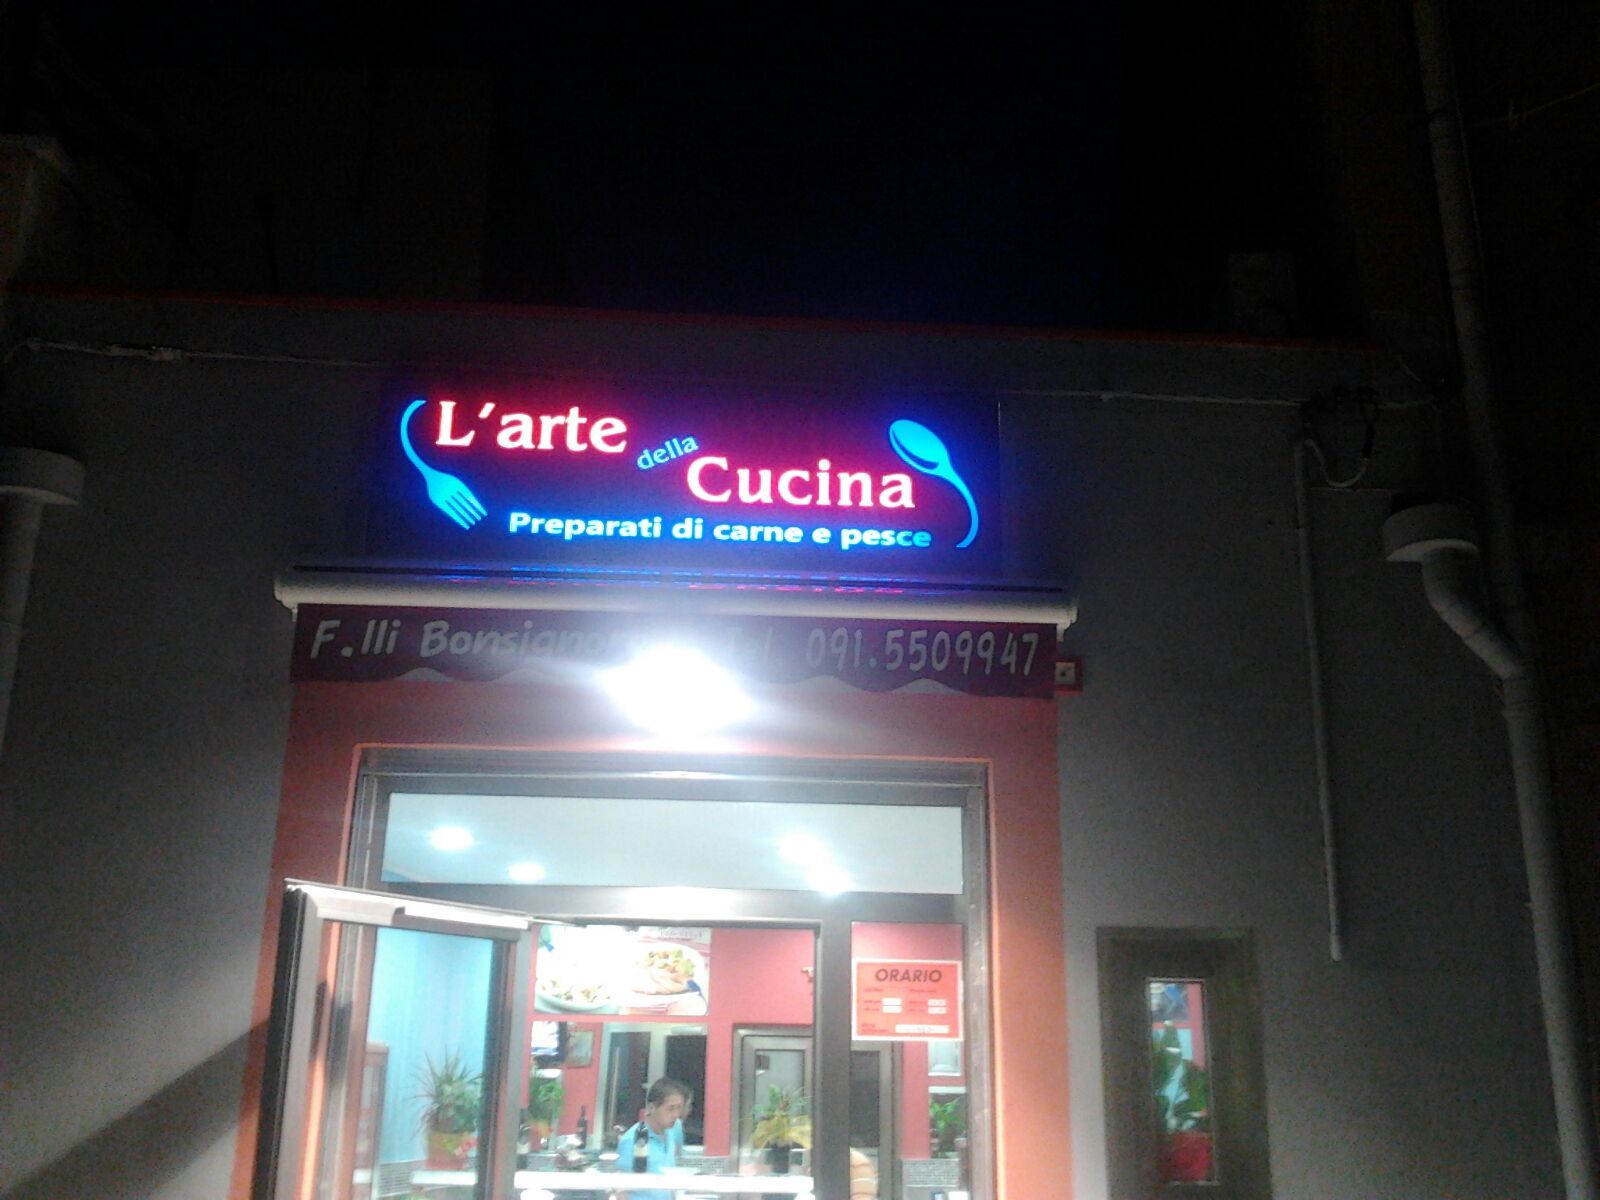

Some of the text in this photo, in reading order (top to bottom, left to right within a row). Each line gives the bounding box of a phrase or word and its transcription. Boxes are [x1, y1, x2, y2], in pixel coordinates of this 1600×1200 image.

[435, 400, 628, 453] L'arte
[636, 435, 699, 470] della
[686, 455, 916, 508] Cucina
[508, 511, 932, 550] Preparati di carne e pesce
[805, 627, 1039, 676] 091.5509947
[875, 967, 943, 983] ORARIO
